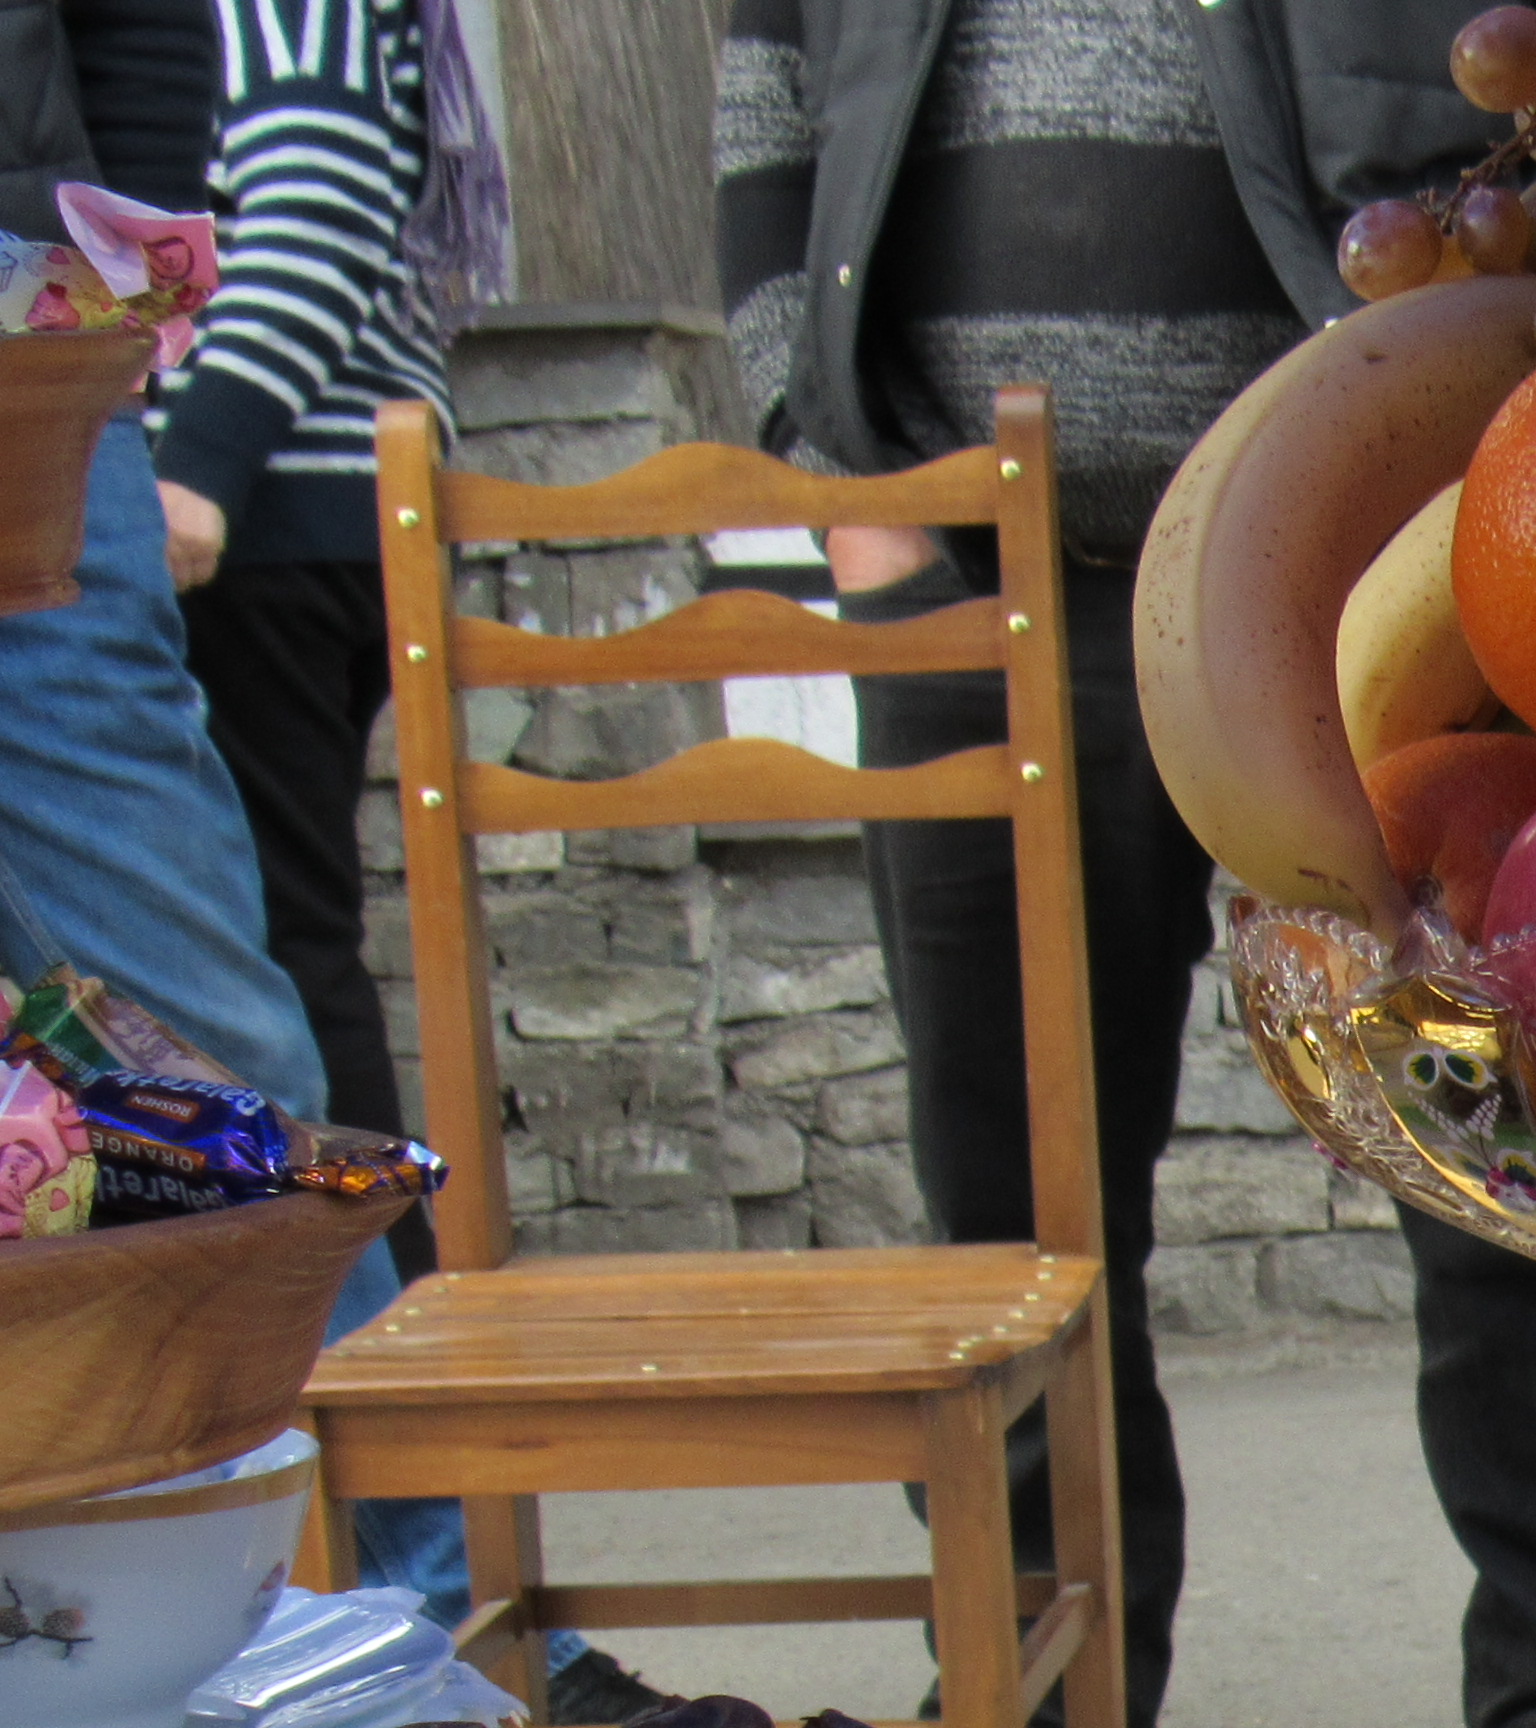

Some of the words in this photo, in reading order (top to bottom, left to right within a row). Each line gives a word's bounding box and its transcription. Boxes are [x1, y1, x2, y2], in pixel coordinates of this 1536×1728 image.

[105, 1070, 267, 1116] Galaretk
[131, 1094, 193, 1118] ROSHEN
[91, 1131, 195, 1173] ORANGE
